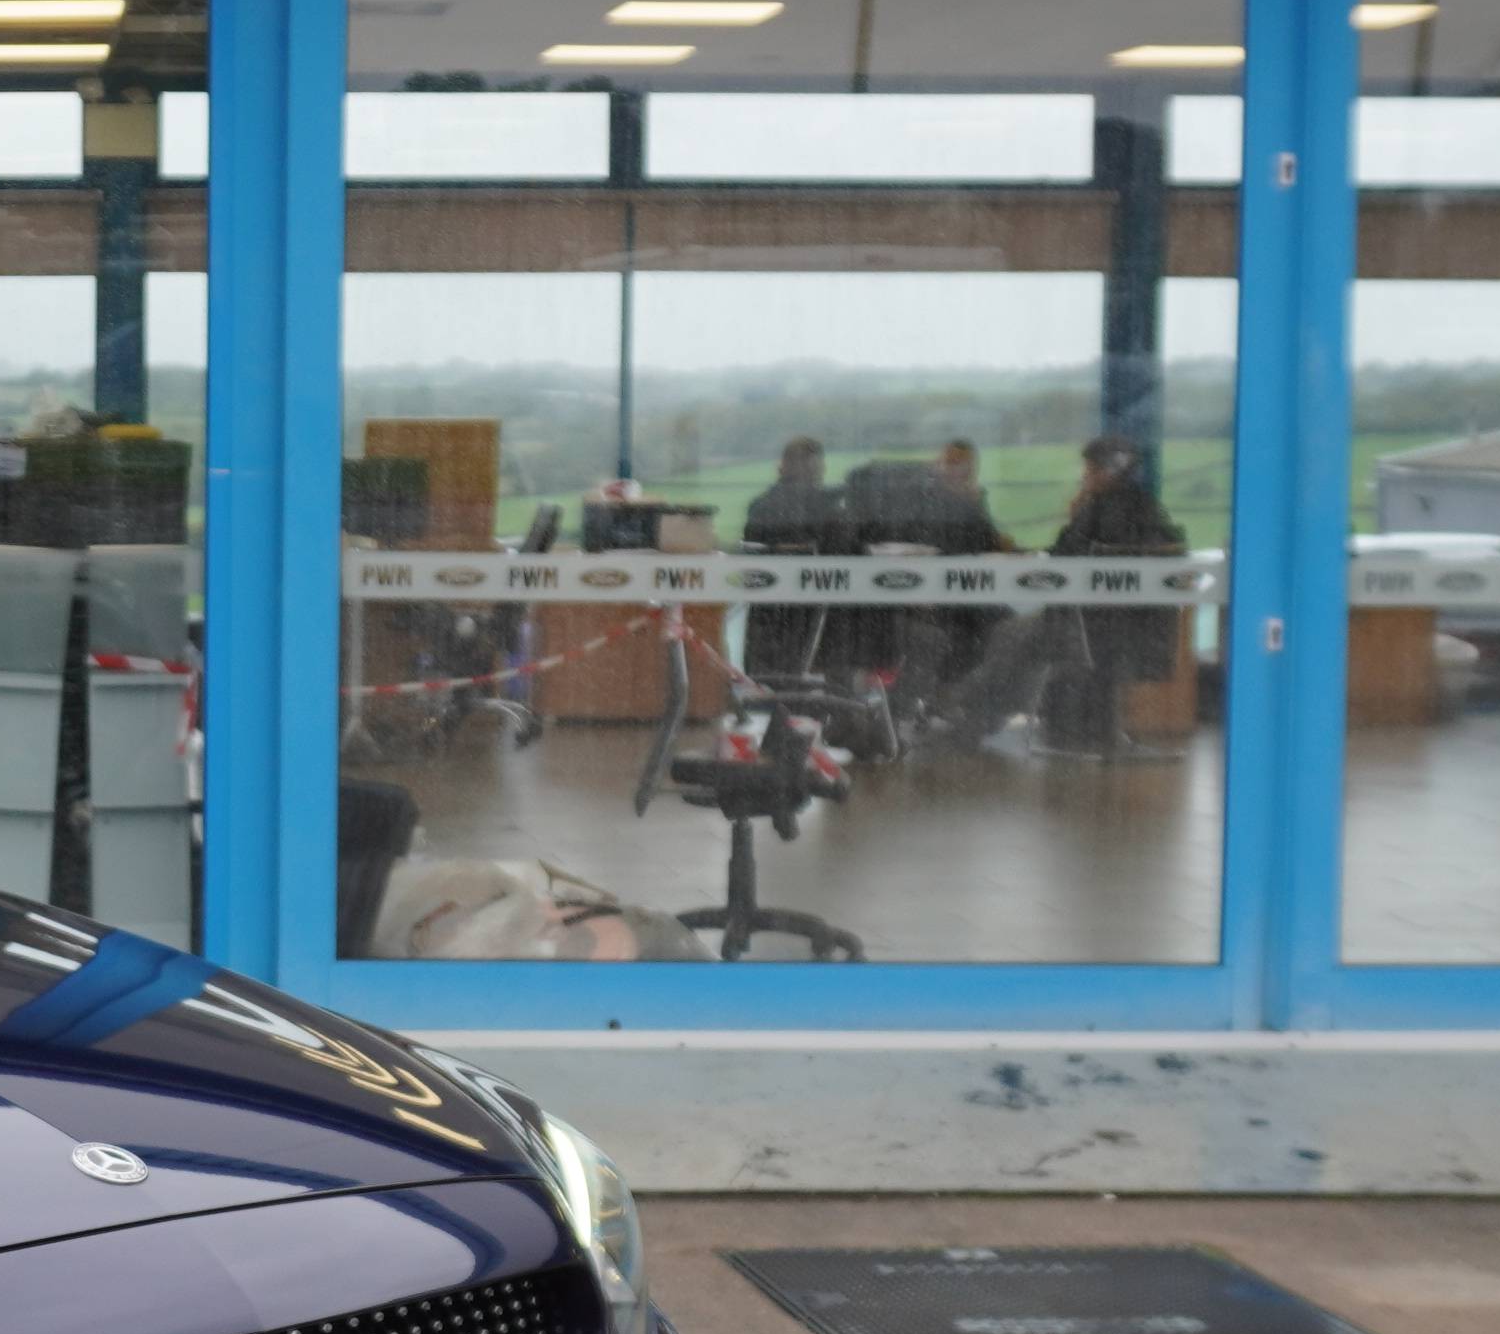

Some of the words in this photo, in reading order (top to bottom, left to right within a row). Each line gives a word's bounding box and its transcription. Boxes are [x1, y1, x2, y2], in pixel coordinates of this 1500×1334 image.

[361, 564, 412, 586] PWM
[509, 565, 559, 589] PWM
[655, 568, 705, 590] PWM
[801, 569, 850, 591] PWM
[945, 569, 996, 591] PWM
[1090, 570, 1141, 592] PWM
